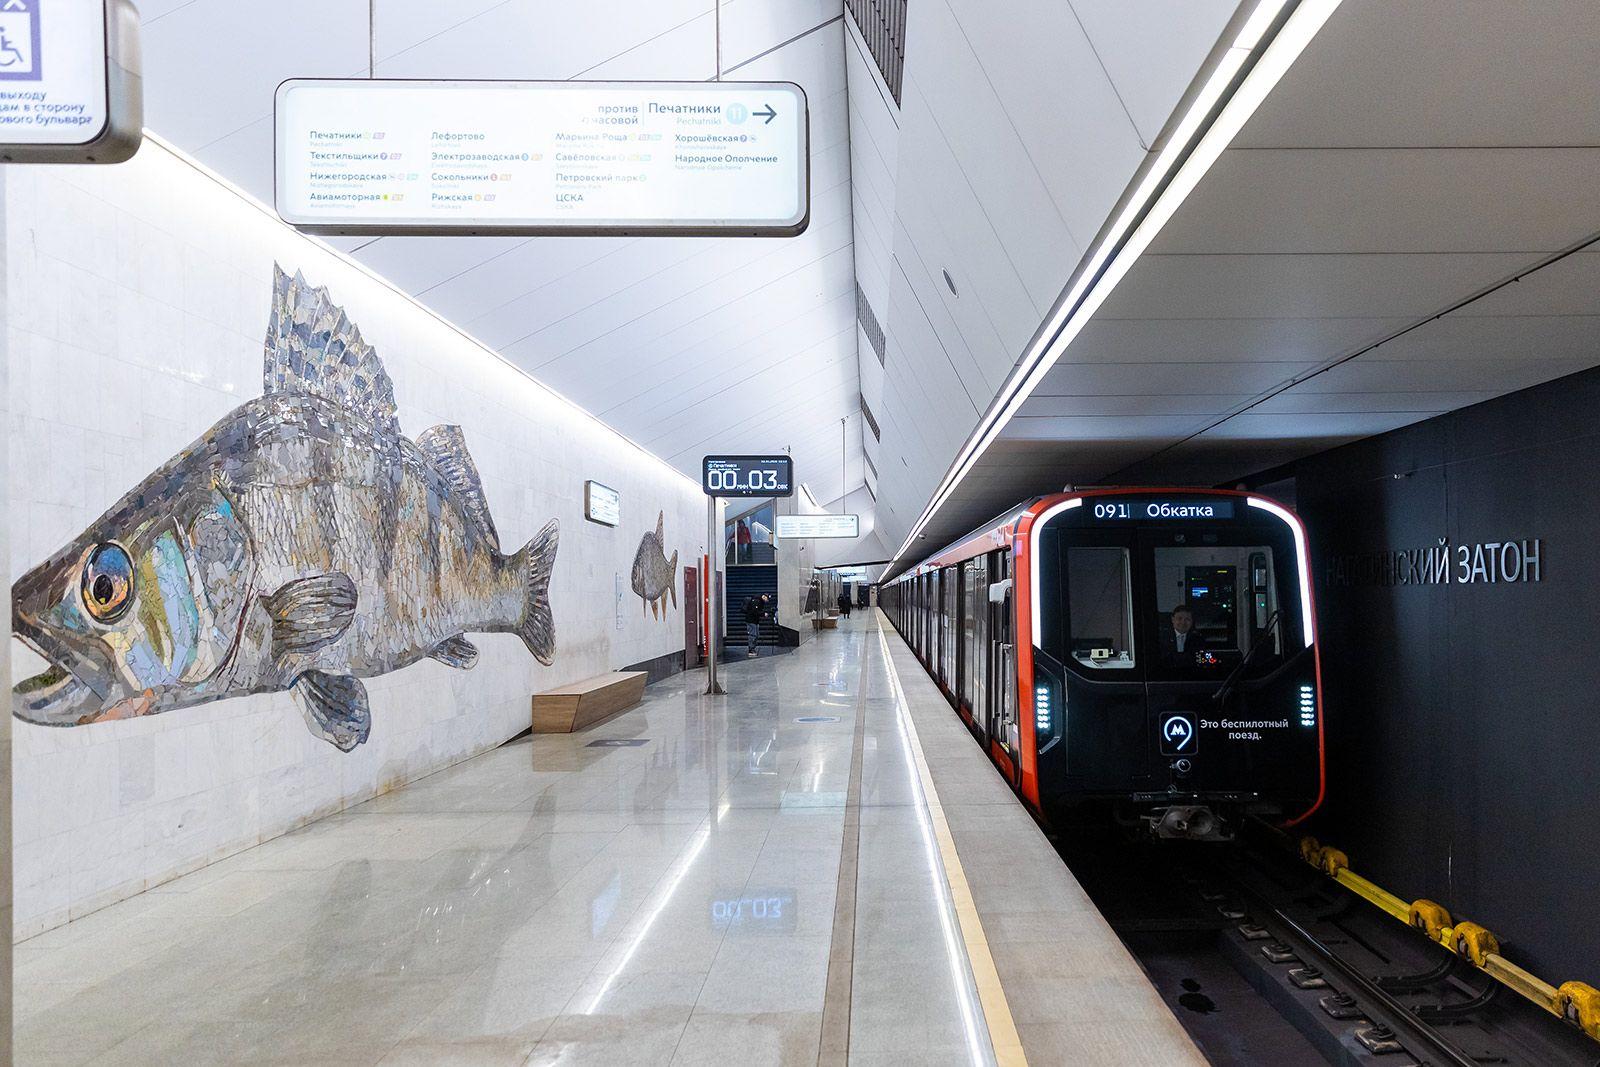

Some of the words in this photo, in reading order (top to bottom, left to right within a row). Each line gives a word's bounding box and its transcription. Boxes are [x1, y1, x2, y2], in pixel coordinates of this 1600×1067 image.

[0, 91, 47, 102] выходу
[34, 104, 86, 114] сторону
[598, 106, 638, 114] против
[648, 103, 721, 114] Печатники
[310, 130, 362, 140] Печатники
[431, 131, 486, 141] Лефортово
[555, 132, 600, 142] Марьина
[602, 132, 628, 143] Роща
[674, 133, 739, 143] Хорошёвская
[310, 151, 379, 161] Текстильщики
[431, 152, 520, 162] Электрозаводская
[555, 152, 617, 161] Савёловская
[674, 154, 723, 164] Народное
[724, 154, 778, 163] Ополчение
[310, 172, 387, 181] Нижегородская
[431, 172, 489, 181] Сокольники
[555, 173, 613, 182] Петровский
[310, 193, 381, 202] Авиамоторная
[431, 193, 473, 202] Рижская
[555, 193, 584, 203] ЦСКА
[708, 470, 737, 490] 00
[748, 470, 778, 490] 03
[1094, 504, 1127, 518] 091
[1146, 503, 1214, 518] Обкатка
[1457, 538, 1541, 585] ЗАТОН
[1200, 719, 1219, 729] Это
[1220, 718, 1289, 729] беспилотный
[1228, 731, 1262, 741] поезд.
